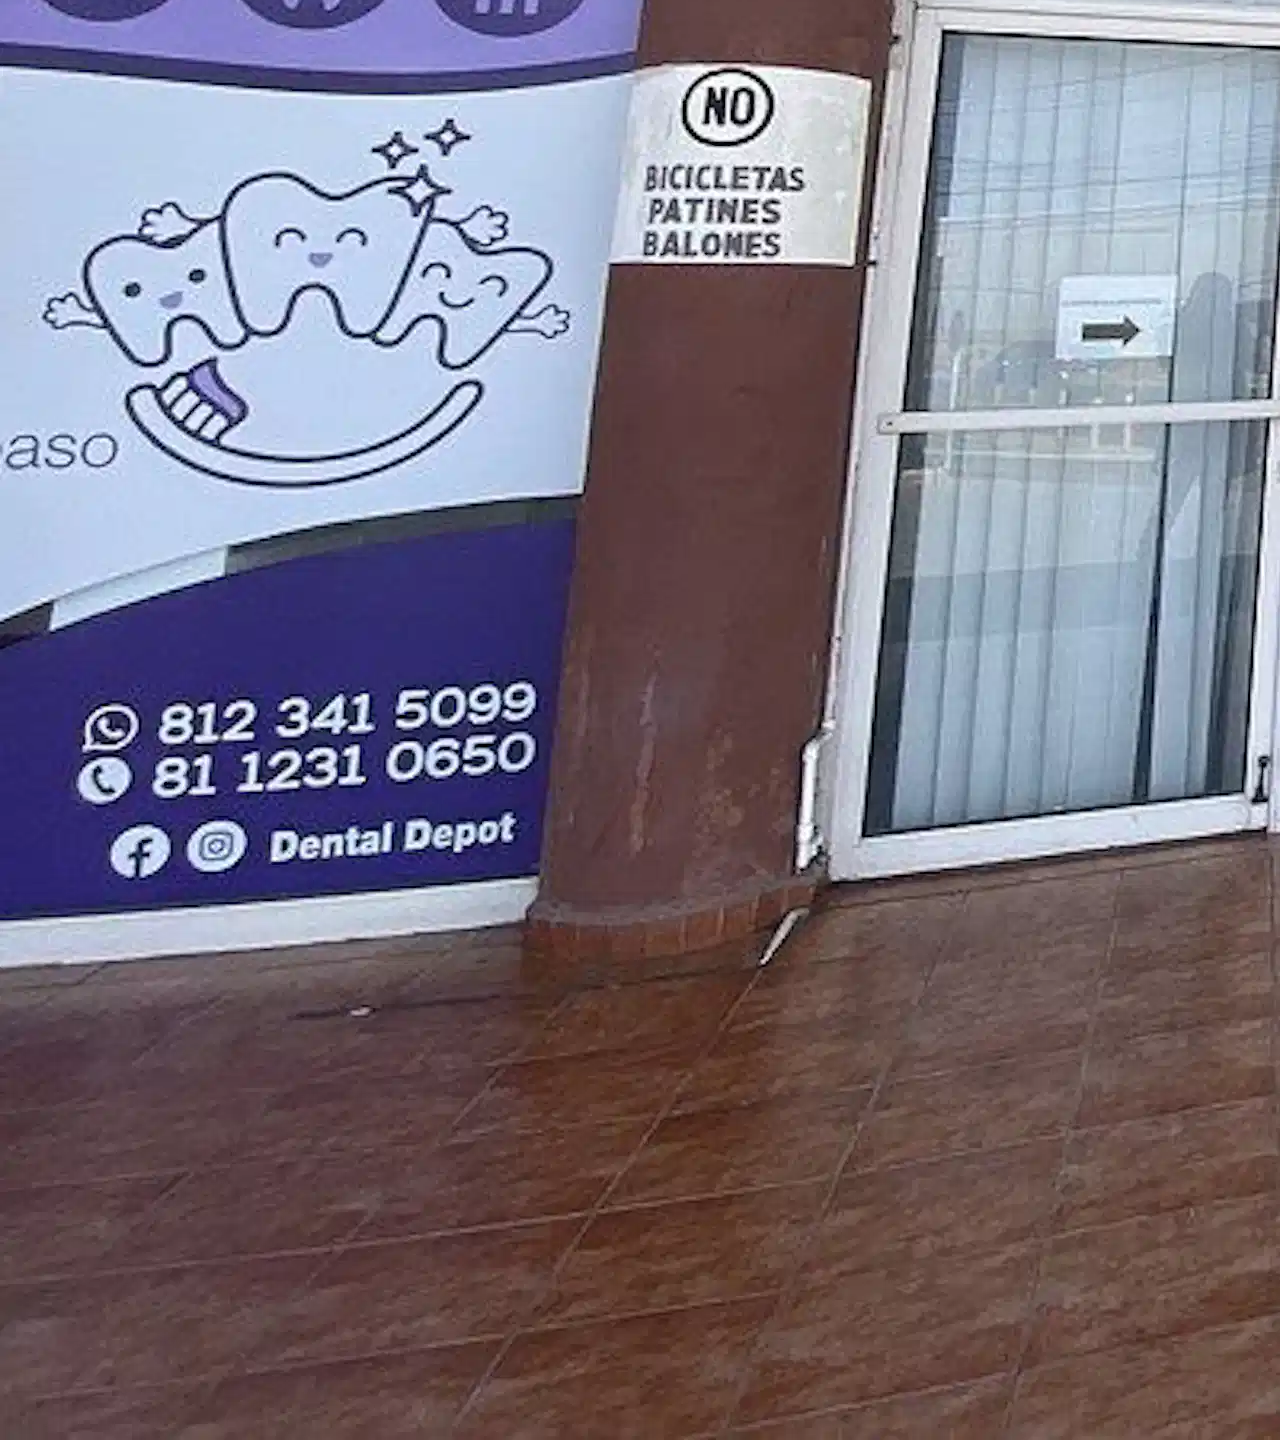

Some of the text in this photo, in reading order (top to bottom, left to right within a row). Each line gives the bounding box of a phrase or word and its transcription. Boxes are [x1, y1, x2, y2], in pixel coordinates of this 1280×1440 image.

[703, 86, 756, 126] NO
[643, 163, 806, 192] BICICLETAS
[647, 198, 782, 225] PATINES
[641, 230, 782, 257] BALONES
[0, 433, 119, 470] aso
[157, 681, 537, 747] 812 341 5099
[151, 730, 536, 800] 81 1231 0650
[269, 810, 517, 864] Dental Depot
